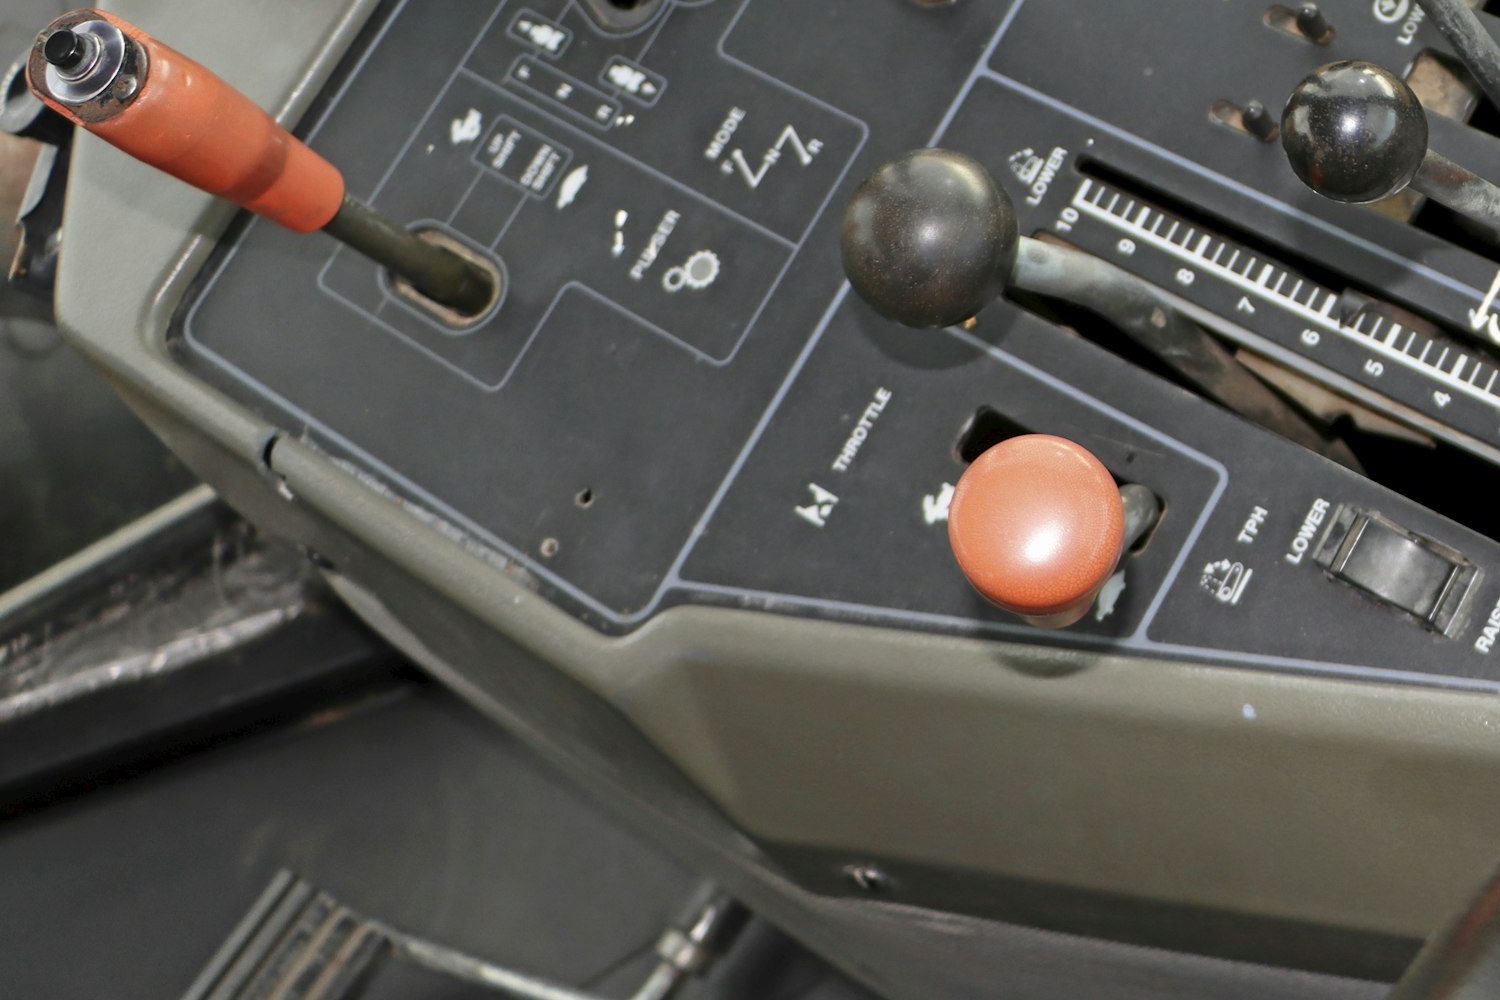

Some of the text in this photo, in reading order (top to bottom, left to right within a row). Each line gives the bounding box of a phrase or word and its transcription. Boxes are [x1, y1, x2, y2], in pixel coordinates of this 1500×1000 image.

[1396, 2, 1427, 46] LOW
[705, 106, 746, 160] MODE
[806, 138, 824, 155] R
[1026, 146, 1068, 206] LOWER
[1055, 207, 1079, 231] 10
[1117, 238, 1136, 255] 9
[1176, 267, 1195, 285] 8
[1236, 296, 1256, 314] 7
[1301, 328, 1320, 346] 6
[1364, 358, 1384, 377] 5
[1432, 390, 1452, 409] 4
[832, 387, 892, 471] THROTTLE
[1237, 505, 1268, 543] TPH
[1285, 498, 1331, 564] LOWER
